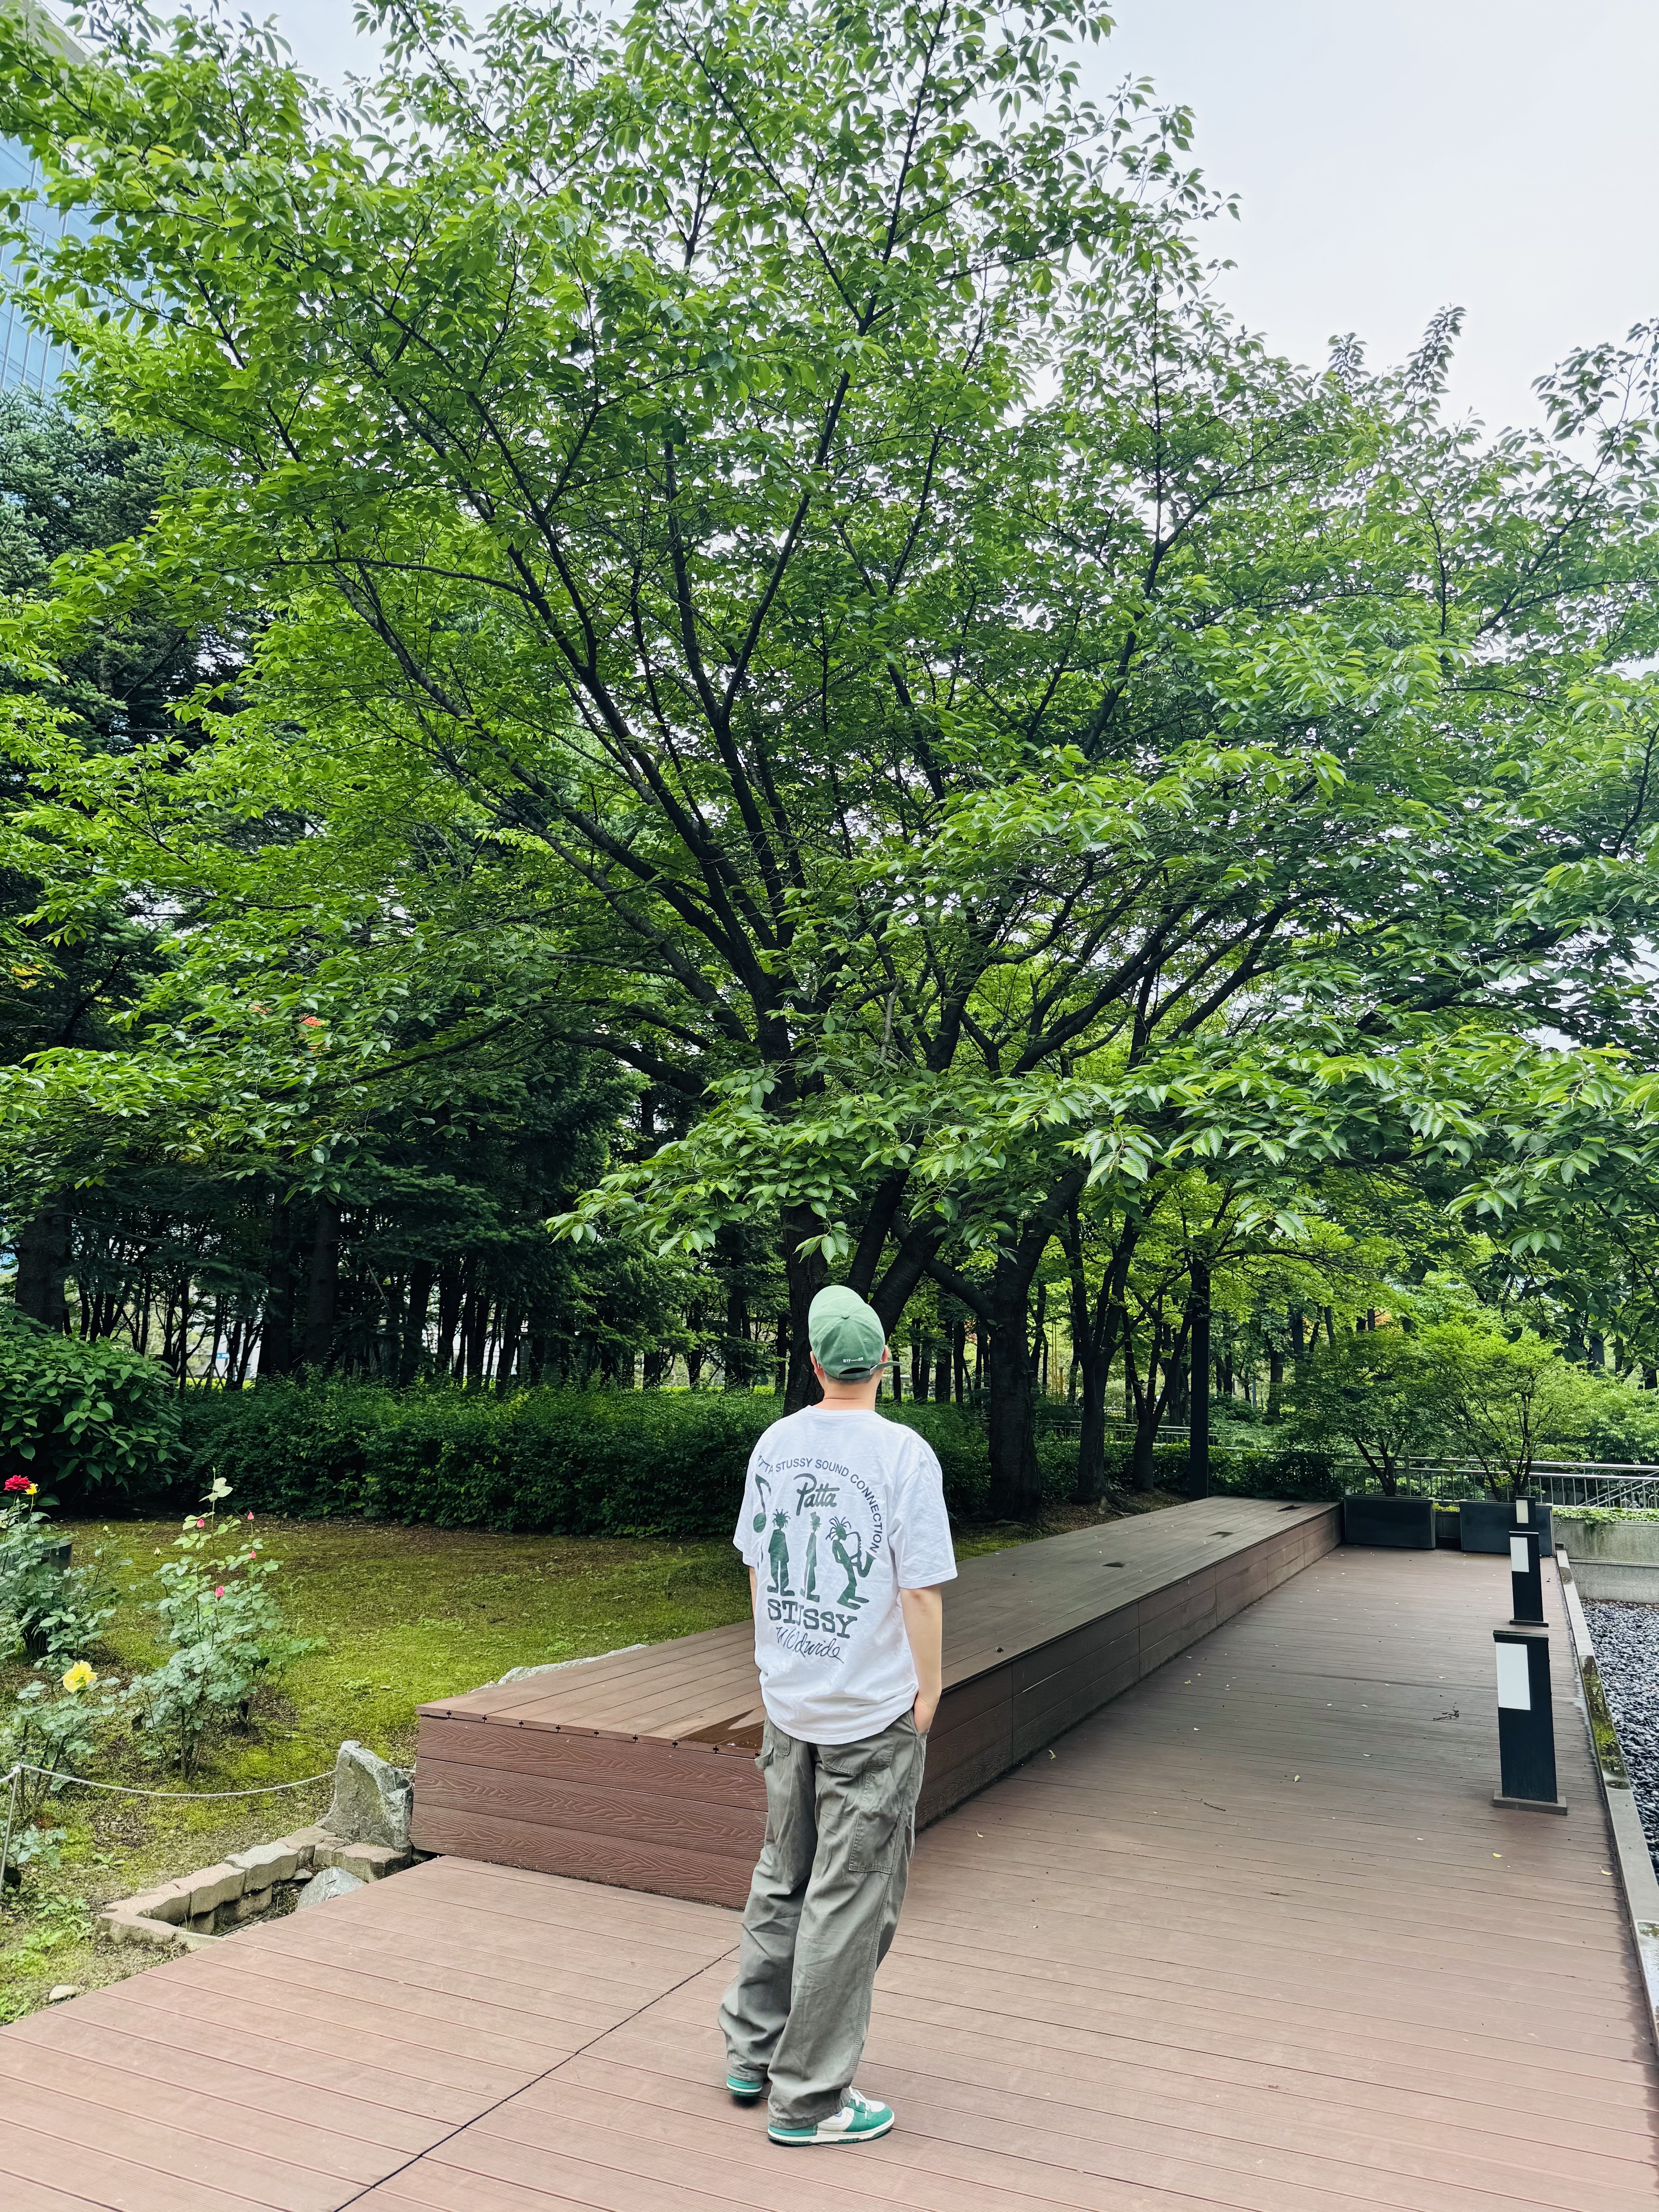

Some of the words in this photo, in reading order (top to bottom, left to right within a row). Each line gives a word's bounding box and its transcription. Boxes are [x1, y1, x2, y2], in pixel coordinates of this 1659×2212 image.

[776, 1458, 813, 1472] STUSSY
[815, 1459, 849, 1477] SOUND
[850, 1474, 883, 1553] CONNECTION
[793, 1473, 840, 1516] Patta
